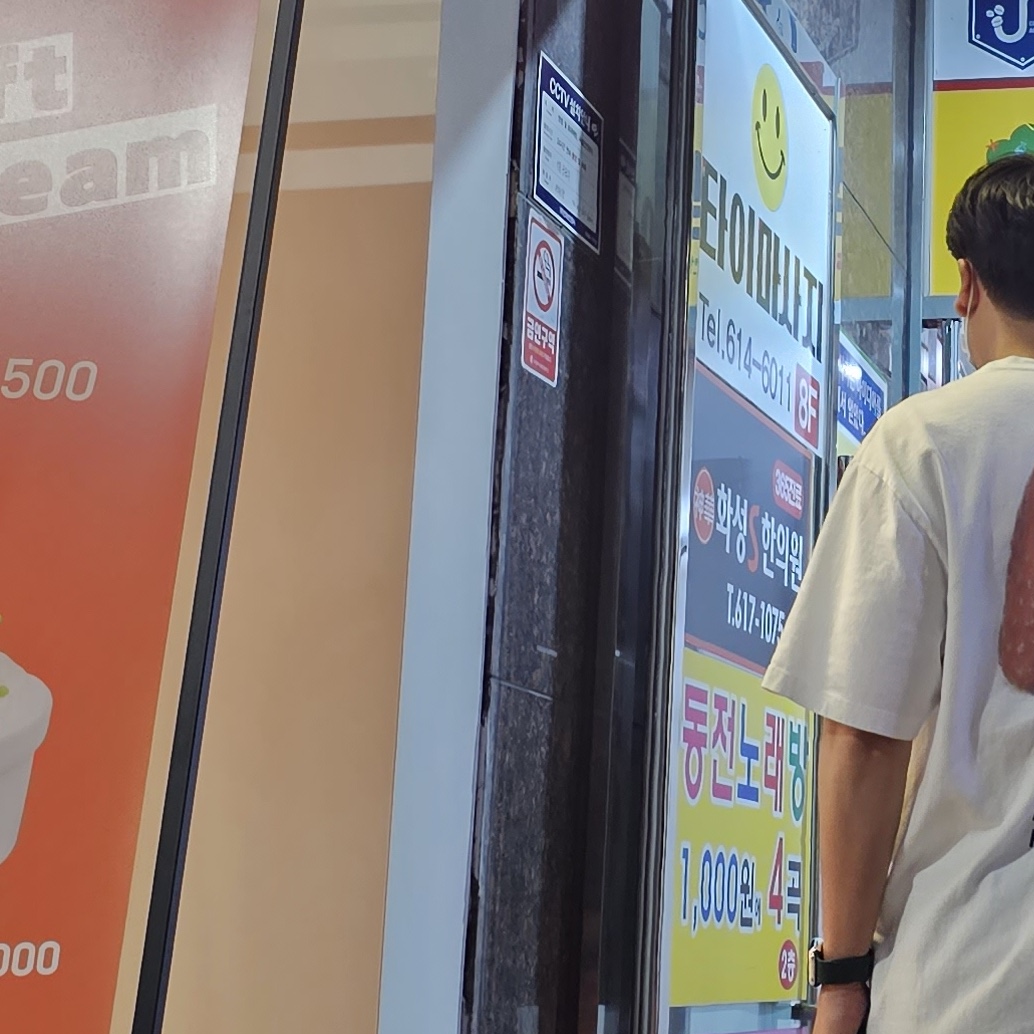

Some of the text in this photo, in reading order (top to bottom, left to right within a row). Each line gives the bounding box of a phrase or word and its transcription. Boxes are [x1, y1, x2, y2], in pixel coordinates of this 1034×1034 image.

[550, 77, 570, 107] CCTV
[700, 156, 824, 364] 타이마사지
[526, 316, 557, 355] 금연구역
[1, 358, 98, 401] 500
[799, 377, 818, 433] 8F
[683, 683, 809, 822] 동전노래방
[780, 949, 797, 982] 2층
